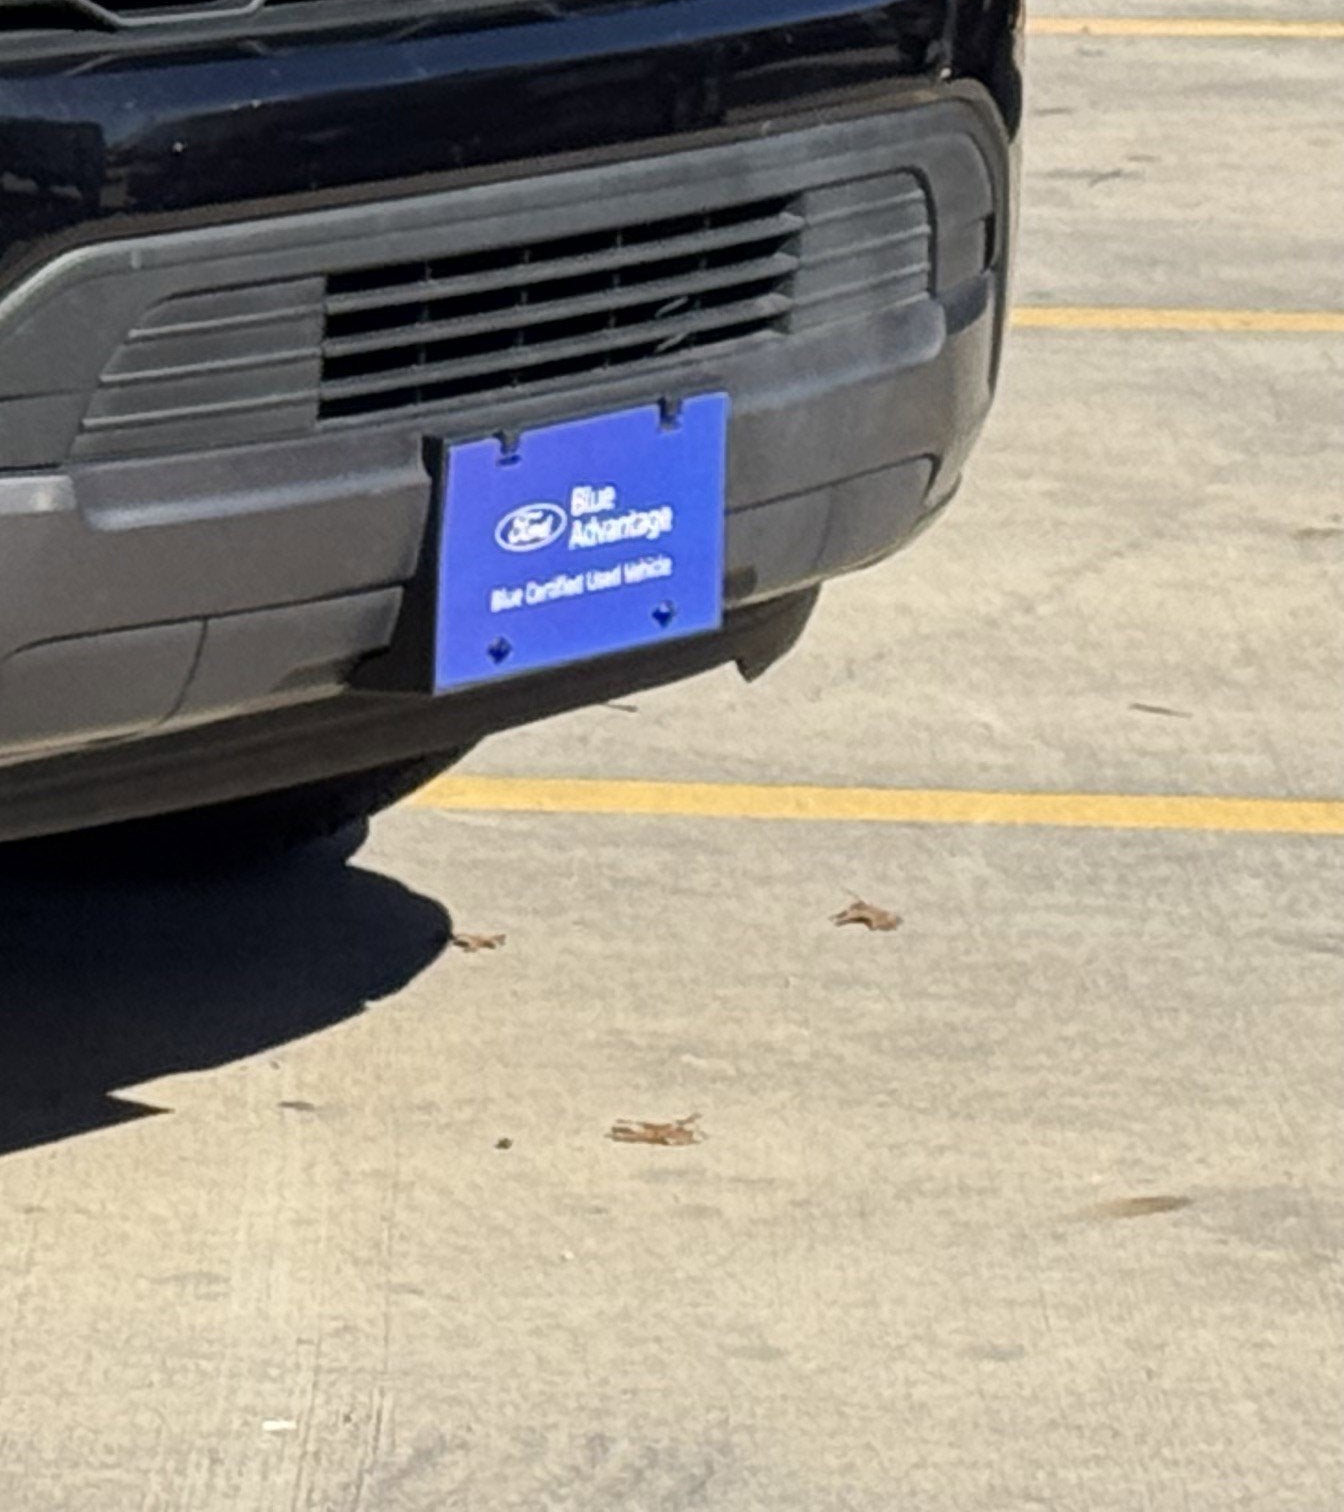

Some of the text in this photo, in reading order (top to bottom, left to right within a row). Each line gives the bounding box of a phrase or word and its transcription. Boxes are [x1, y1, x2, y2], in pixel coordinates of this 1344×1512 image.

[570, 486, 616, 517] Blue
[507, 510, 553, 543] Ford
[568, 505, 673, 550] Advantage
[490, 554, 673, 613] Blue Certified Used Vehicle
